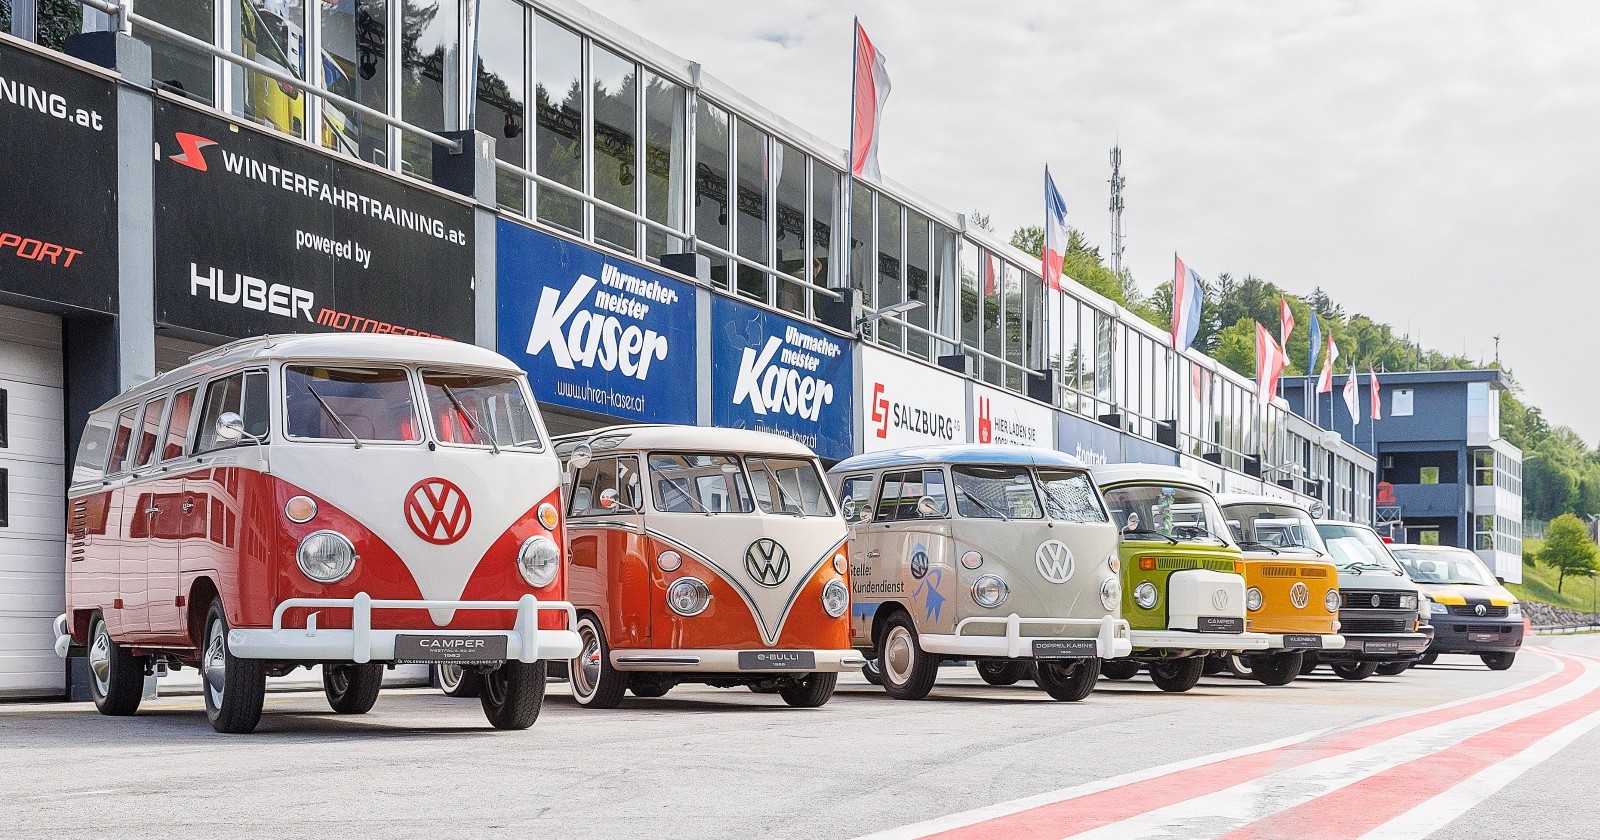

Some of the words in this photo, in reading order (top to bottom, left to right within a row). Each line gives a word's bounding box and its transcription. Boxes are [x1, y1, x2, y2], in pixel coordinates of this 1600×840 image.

[0, 76, 103, 131] NING.at
[222, 149, 466, 246] WINTERFAHRTRAINING.at
[296, 229, 351, 260] powered
[355, 242, 371, 269] by
[190, 262, 315, 323] HUBER
[601, 263, 679, 305] Uhrmacher-
[594, 290, 650, 321] meister
[526, 274, 668, 381] Kaser
[785, 325, 841, 358] Uhrmacher-
[732, 335, 834, 422] Kaser
[780, 348, 819, 372] meister
[557, 379, 645, 413] www.uhren-kaser.at
[893, 402, 953, 440] SALZBURG
[994, 416, 1009, 434] HIER
[1009, 421, 1027, 438] LADEN
[1028, 427, 1036, 441] SIE
[852, 580, 905, 594] Kundendienst
[419, 639, 485, 648] CAMPER
